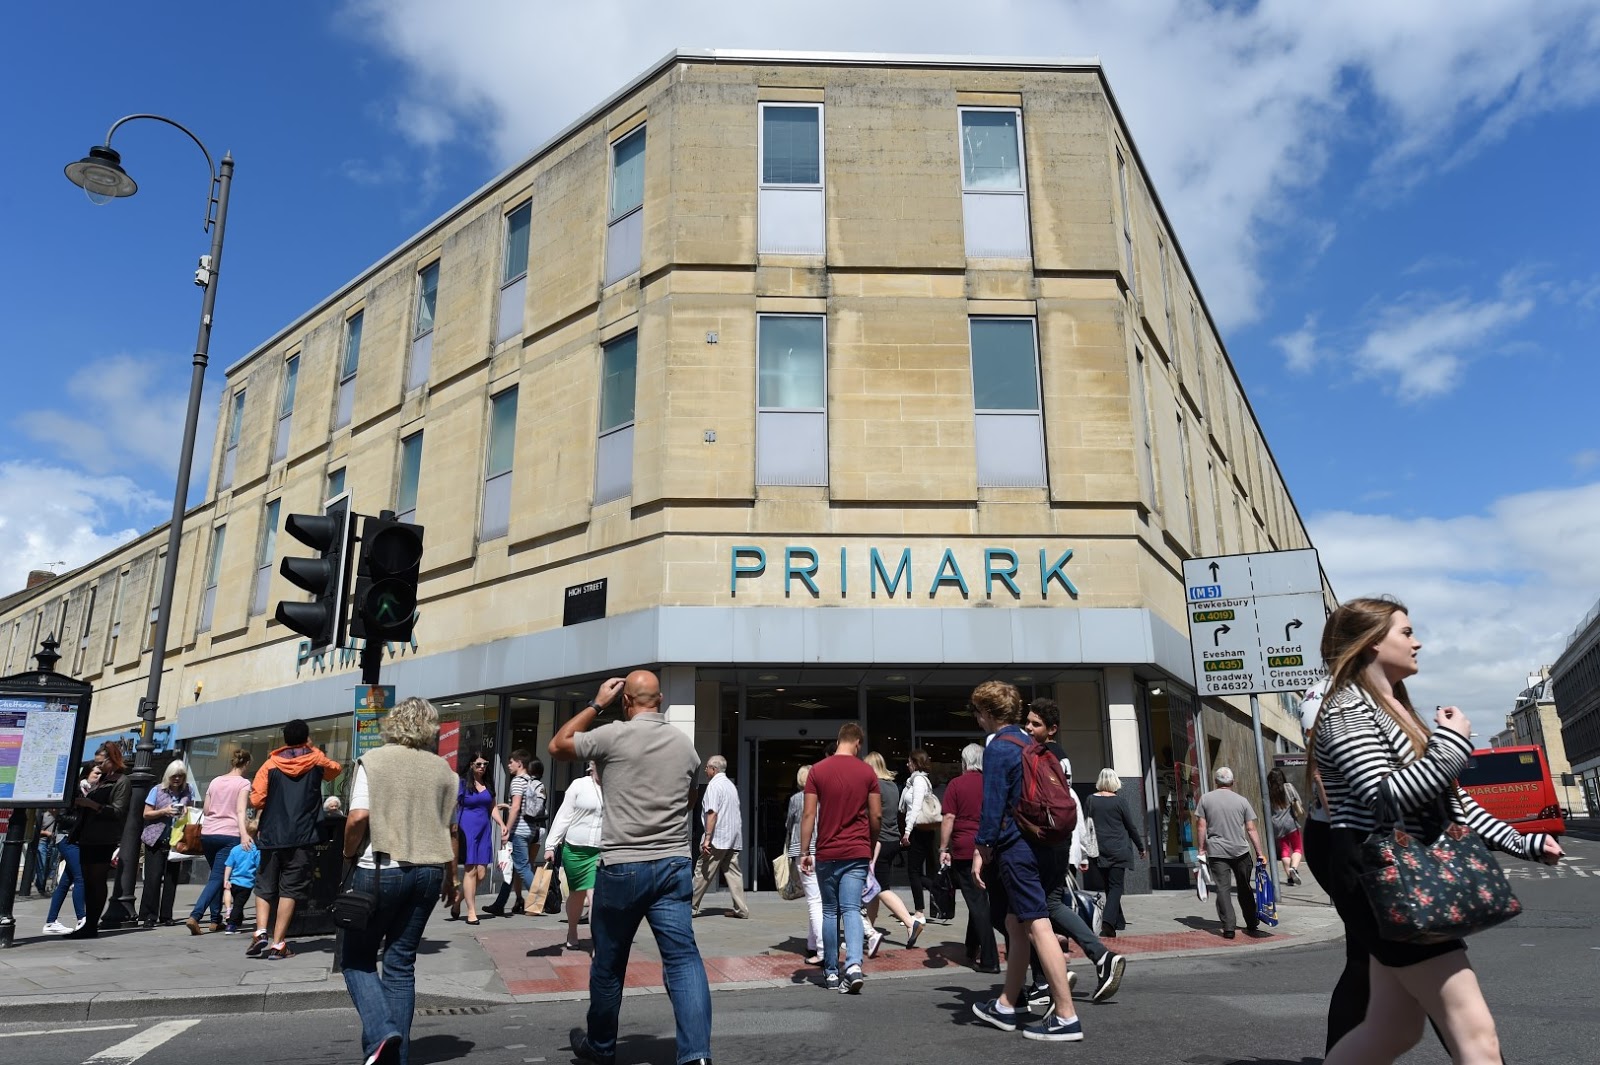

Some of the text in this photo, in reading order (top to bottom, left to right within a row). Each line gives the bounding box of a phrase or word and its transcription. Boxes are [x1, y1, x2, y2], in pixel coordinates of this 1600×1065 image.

[731, 545, 1078, 598] PRIMARK
[568, 581, 603, 597] HIGH STREET
[1193, 600, 1249, 609] Tewkesbury
[1203, 649, 1246, 659] Evesham
[1267, 645, 1302, 654] Oxford
[1205, 673, 1253, 683] Broadway
[1270, 668, 1328, 678] Cirenceste
[1206, 682, 1254, 692] (B4632)
[1467, 783, 1538, 796] MARCHANTS
